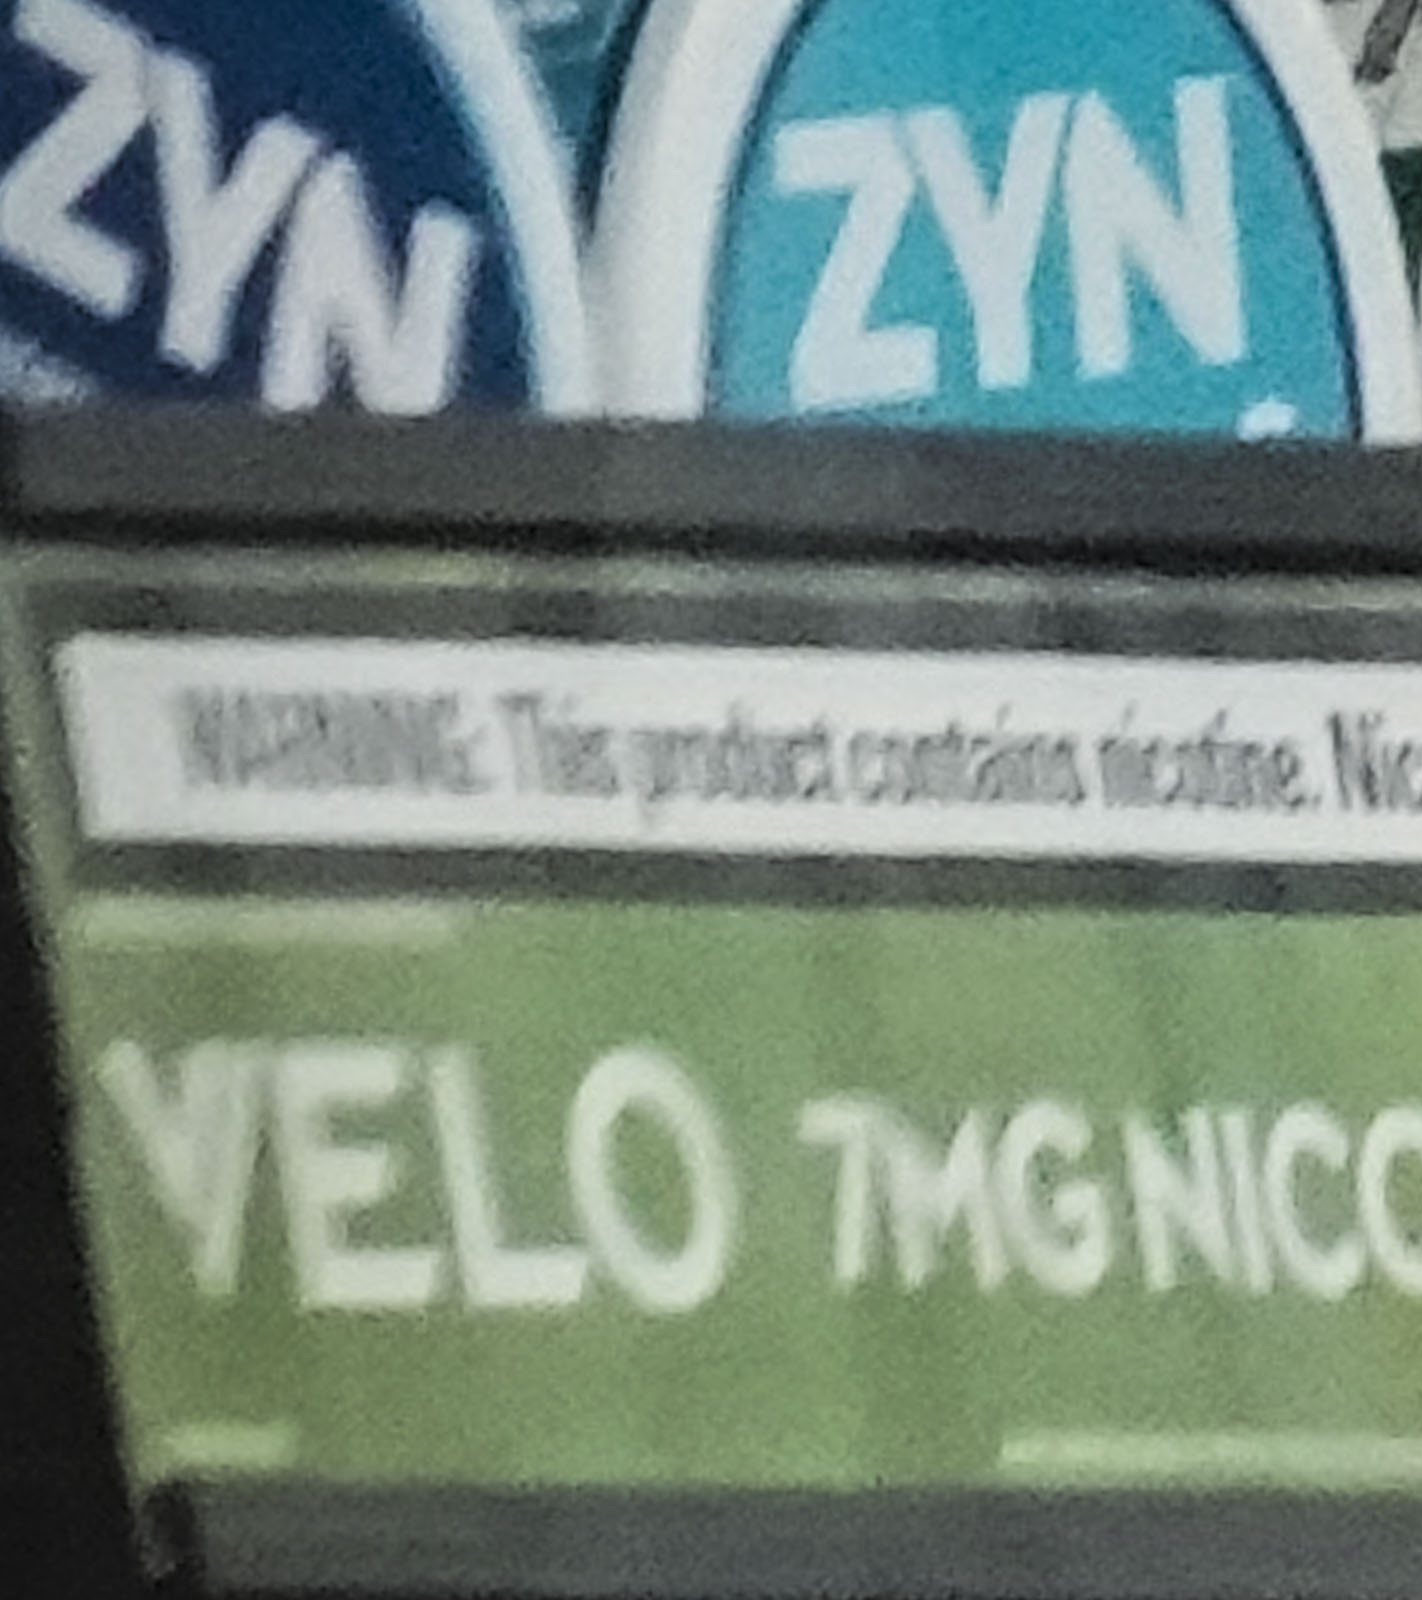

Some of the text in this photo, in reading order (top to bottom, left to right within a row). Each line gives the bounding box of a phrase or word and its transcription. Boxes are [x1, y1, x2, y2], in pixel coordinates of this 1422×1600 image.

[773, 72, 1248, 414] ZYN
[92, 1036, 736, 1315] VELO
[796, 1092, 1112, 1298] 7MG
